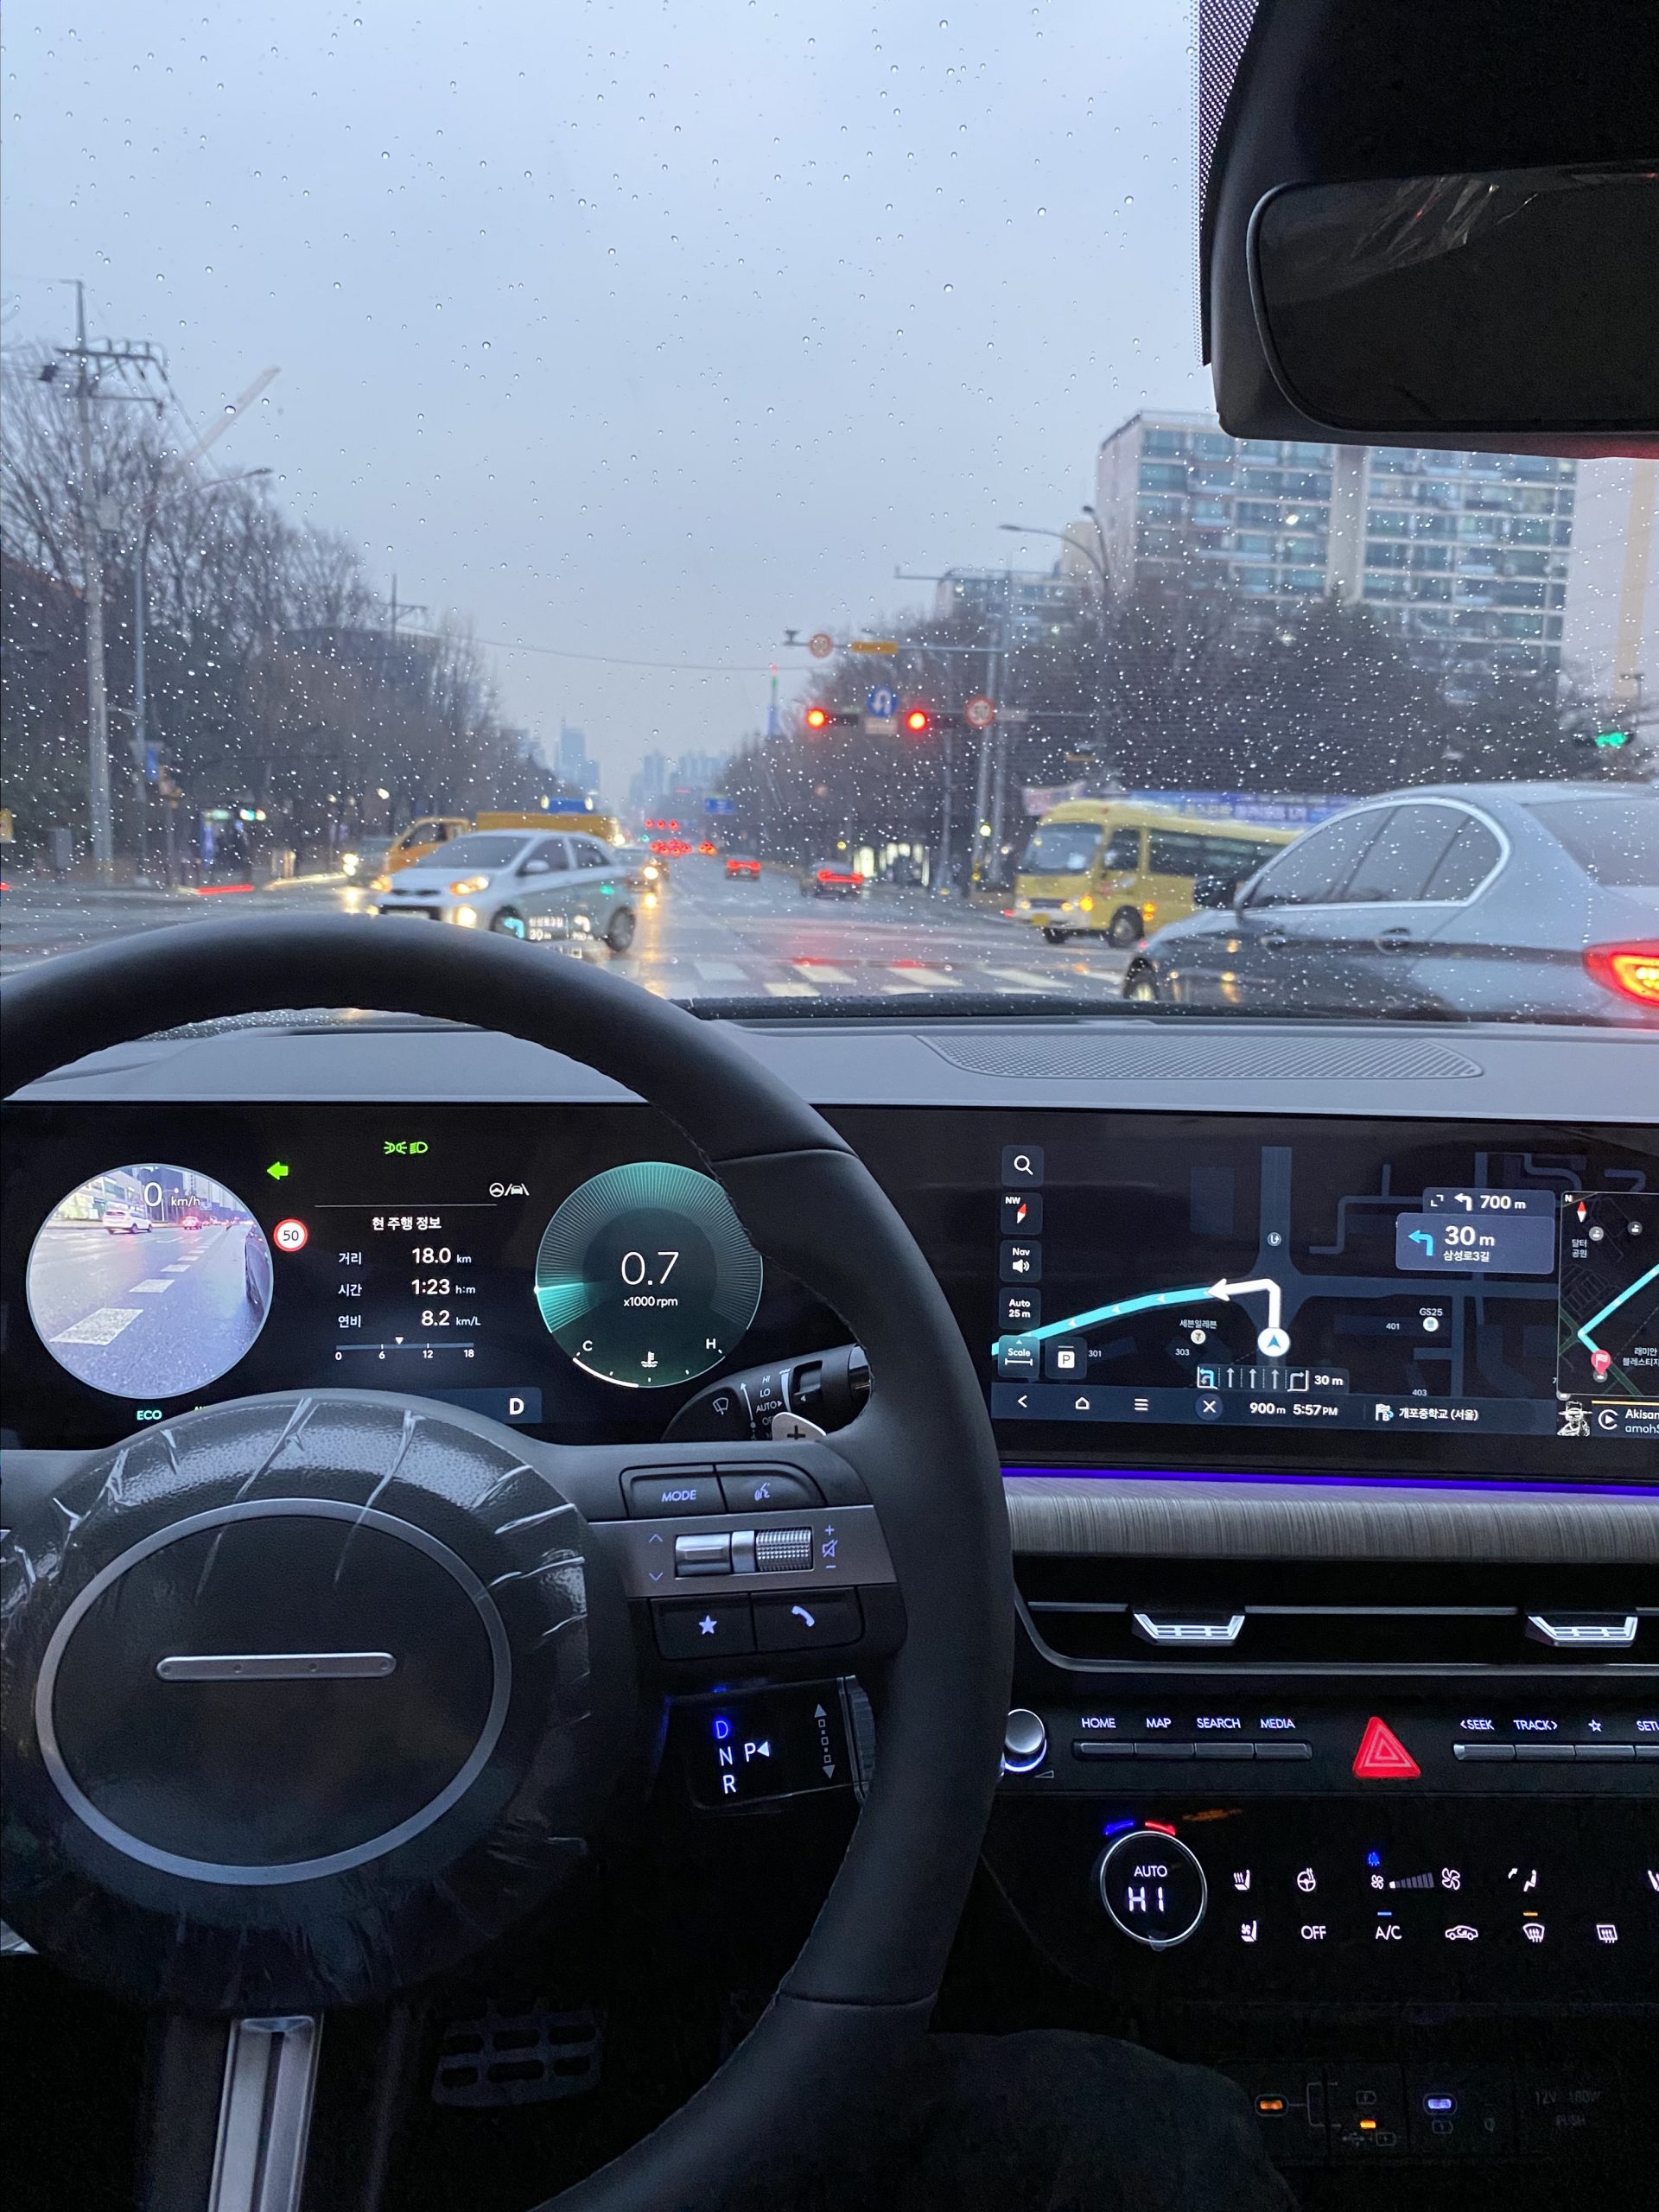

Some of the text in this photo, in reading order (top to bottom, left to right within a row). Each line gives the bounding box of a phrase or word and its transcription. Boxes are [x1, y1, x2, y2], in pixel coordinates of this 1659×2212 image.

[143, 1183, 162, 1206] 0
[171, 1196, 200, 1206] km/h
[1480, 1195, 1511, 1209] 700
[372, 1217, 442, 1230] 현 주행 정보
[283, 1230, 299, 1242] 50
[1445, 1226, 1495, 1246] 30 m
[339, 1252, 361, 1265] 거리
[412, 1248, 451, 1263] 18.0
[1444, 1250, 1489, 1262] 삼성로3길
[622, 1252, 678, 1285] 0.7
[339, 1279, 475, 1296] 시간 1:23 h:m
[624, 1296, 677, 1308] x1000 rpm
[1009, 1299, 1030, 1307] Auto
[339, 1310, 480, 1328] 연비 8.2 km/L
[1179, 1319, 1217, 1329] 세븐일레븐
[582, 1340, 592, 1351] C
[706, 1338, 715, 1349] H
[423, 1350, 433, 1358] 12
[464, 1349, 474, 1357] 18
[1008, 1348, 1030, 1357] Scale
[762, 1375, 772, 1383] HI
[1314, 1376, 1329, 1385] 30
[760, 1389, 771, 1398] LO
[510, 1398, 524, 1414] D
[756, 1401, 777, 1413] AUTO
[1250, 1402, 1274, 1414] 900
[1294, 1404, 1321, 1415] 5:57
[137, 1410, 162, 1420] ECO
[1399, 1408, 1478, 1421] 개포중학교 (서울)
[662, 1490, 696, 1502] MODE
[1082, 1718, 1116, 1728] HOME
[1147, 1718, 1171, 1728] MAP
[1197, 1718, 1241, 1728] SEARCH
[1261, 1719, 1295, 1728] MEDIA
[1466, 1719, 1495, 1731] SEEK
[1513, 1719, 1551, 1731] TRACK
[715, 1721, 728, 1739] D
[720, 1746, 733, 1766] N
[743, 1744, 756, 1763] P
[723, 1775, 736, 1794] R
[1135, 1866, 1167, 1877] AUTO
[1301, 1926, 1326, 1939] OFF
[1376, 1925, 1402, 1940] A/C
